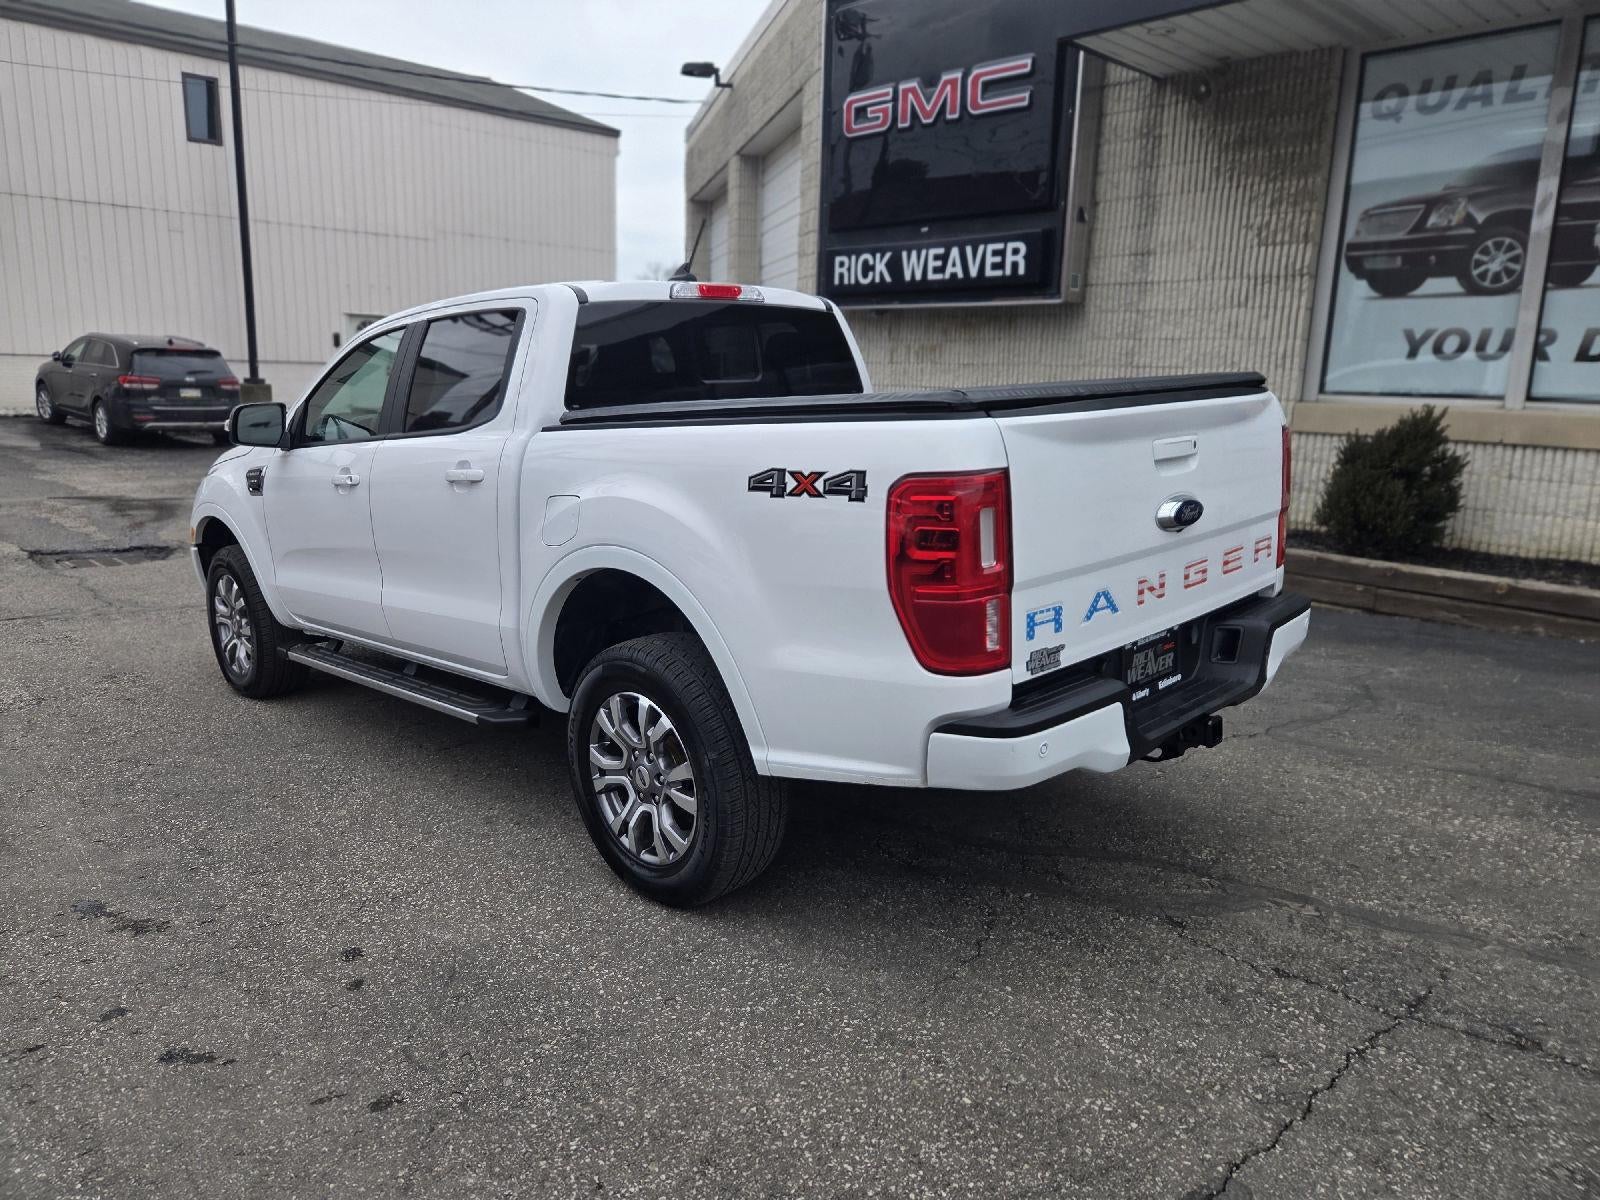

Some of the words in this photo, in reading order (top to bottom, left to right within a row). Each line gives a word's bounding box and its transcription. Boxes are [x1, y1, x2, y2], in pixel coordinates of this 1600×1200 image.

[842, 54, 1035, 138] GMC
[834, 252, 893, 286] RICK
[902, 241, 1027, 283] WEAVER
[1403, 327, 1558, 361] YOUR
[1025, 535, 1273, 642] RANGER
[1127, 652, 1175, 685] WEAVER
[1132, 647, 1155, 668] RICK
